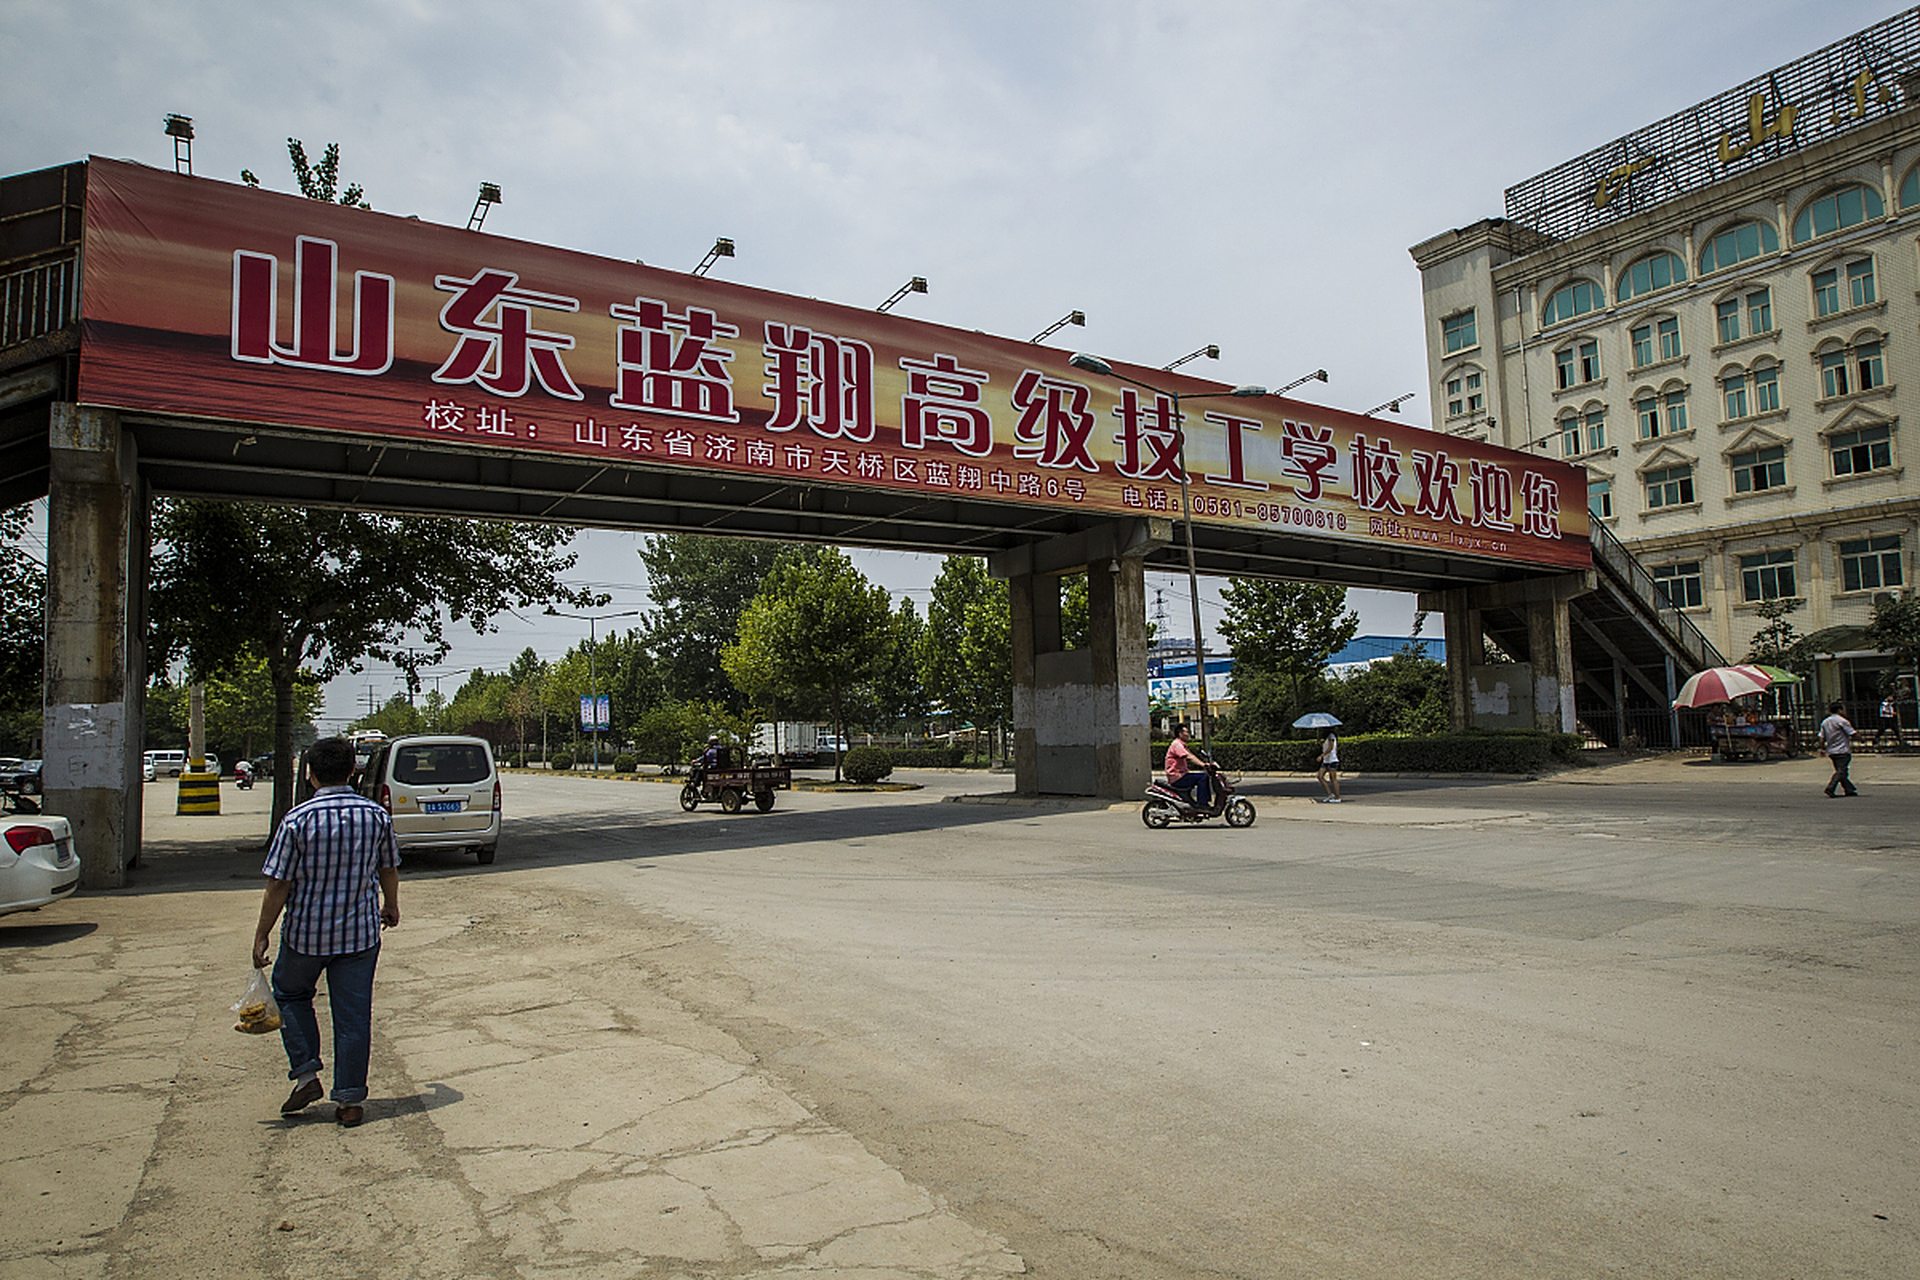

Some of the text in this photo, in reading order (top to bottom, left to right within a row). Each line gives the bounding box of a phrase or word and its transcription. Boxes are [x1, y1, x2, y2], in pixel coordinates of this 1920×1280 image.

[231, 235, 1562, 541] 山东蓝翔高级技工学校欢迎您
